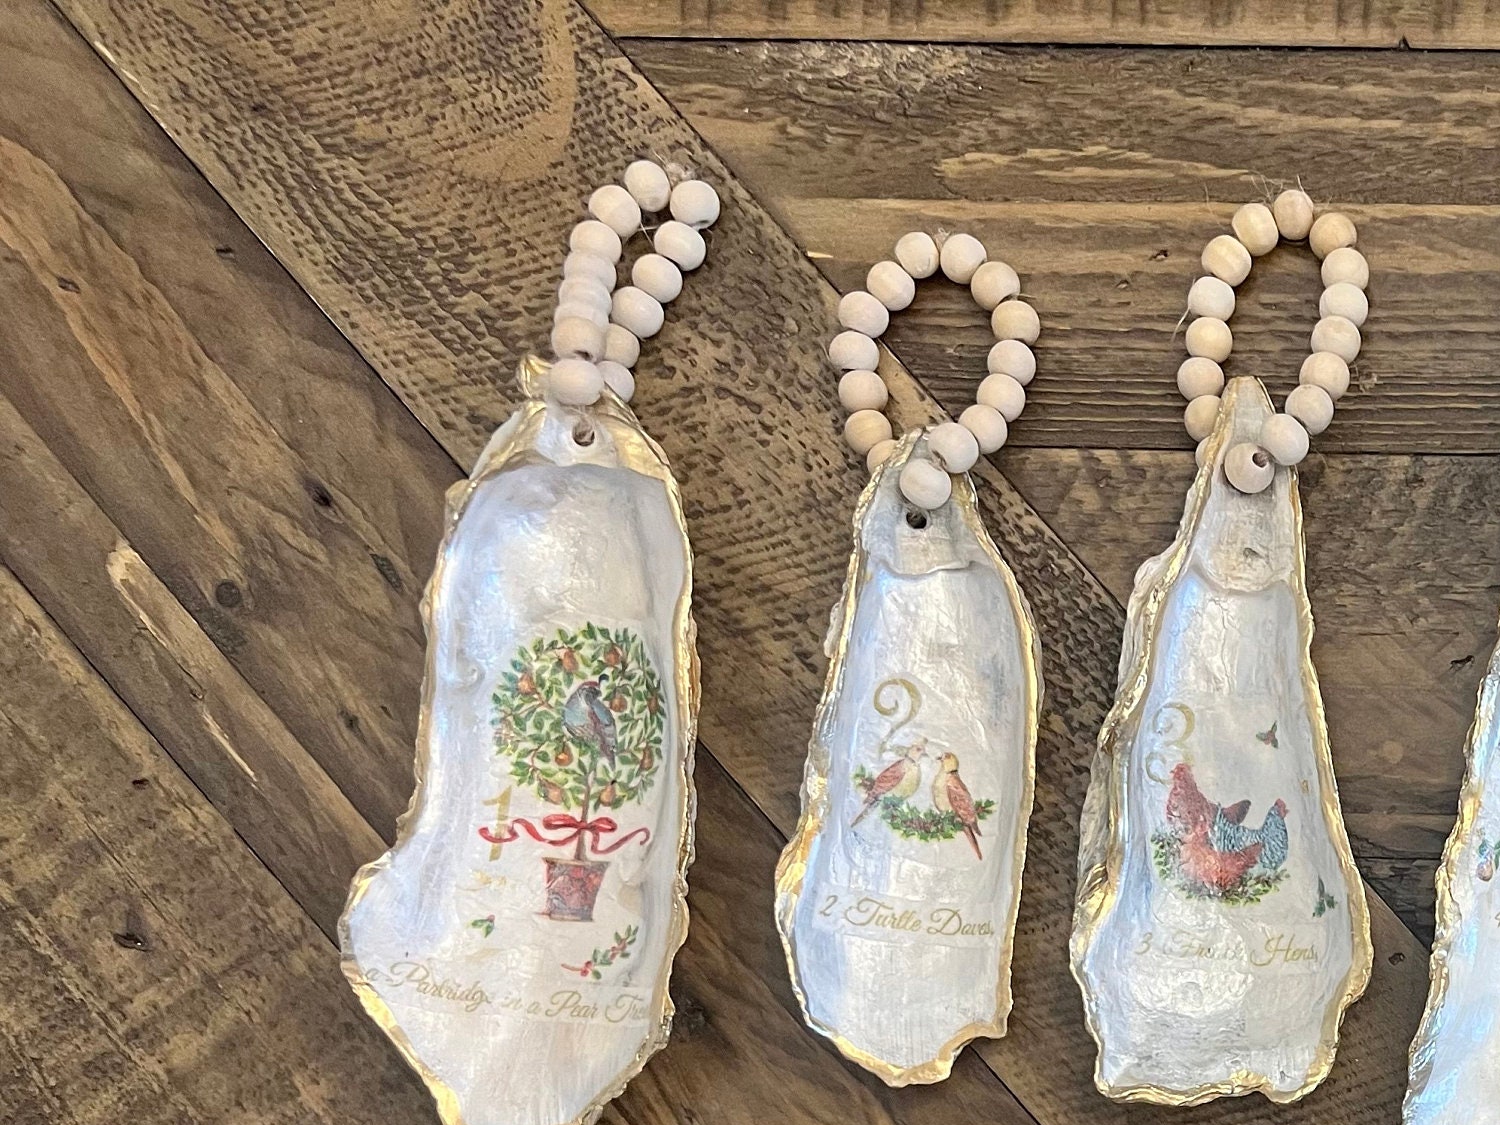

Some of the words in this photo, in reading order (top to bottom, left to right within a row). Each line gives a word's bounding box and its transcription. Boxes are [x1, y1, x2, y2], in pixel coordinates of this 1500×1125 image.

[874, 678, 928, 760] 2
[819, 895, 838, 916] 2
[844, 897, 922, 932] Turtle
[545, 990, 599, 1019] Pear
